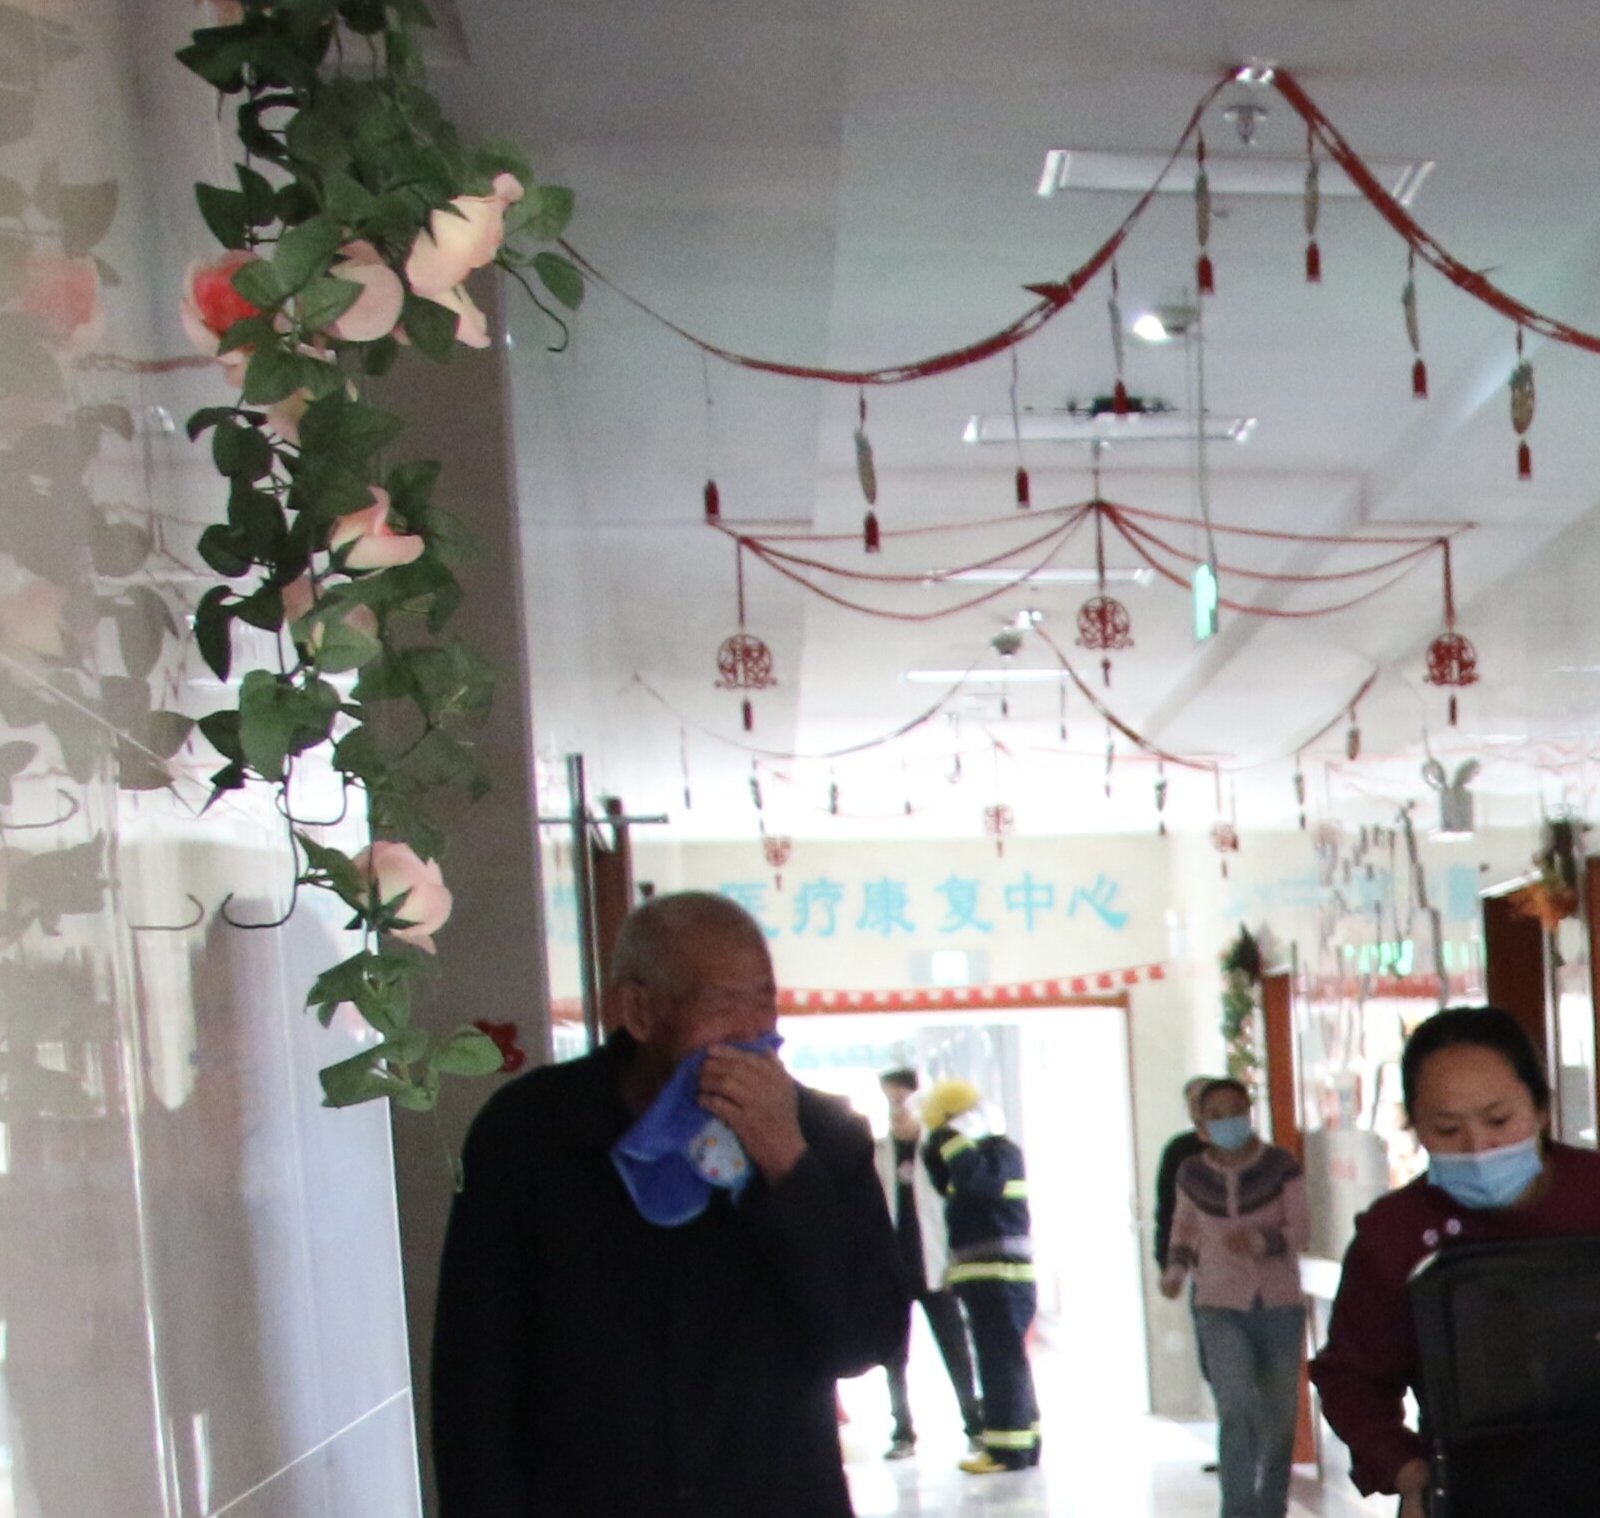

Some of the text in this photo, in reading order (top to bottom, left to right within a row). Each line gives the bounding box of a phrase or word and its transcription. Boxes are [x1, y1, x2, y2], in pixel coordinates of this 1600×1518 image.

[720, 871, 1131, 938] 医疗康复中心
